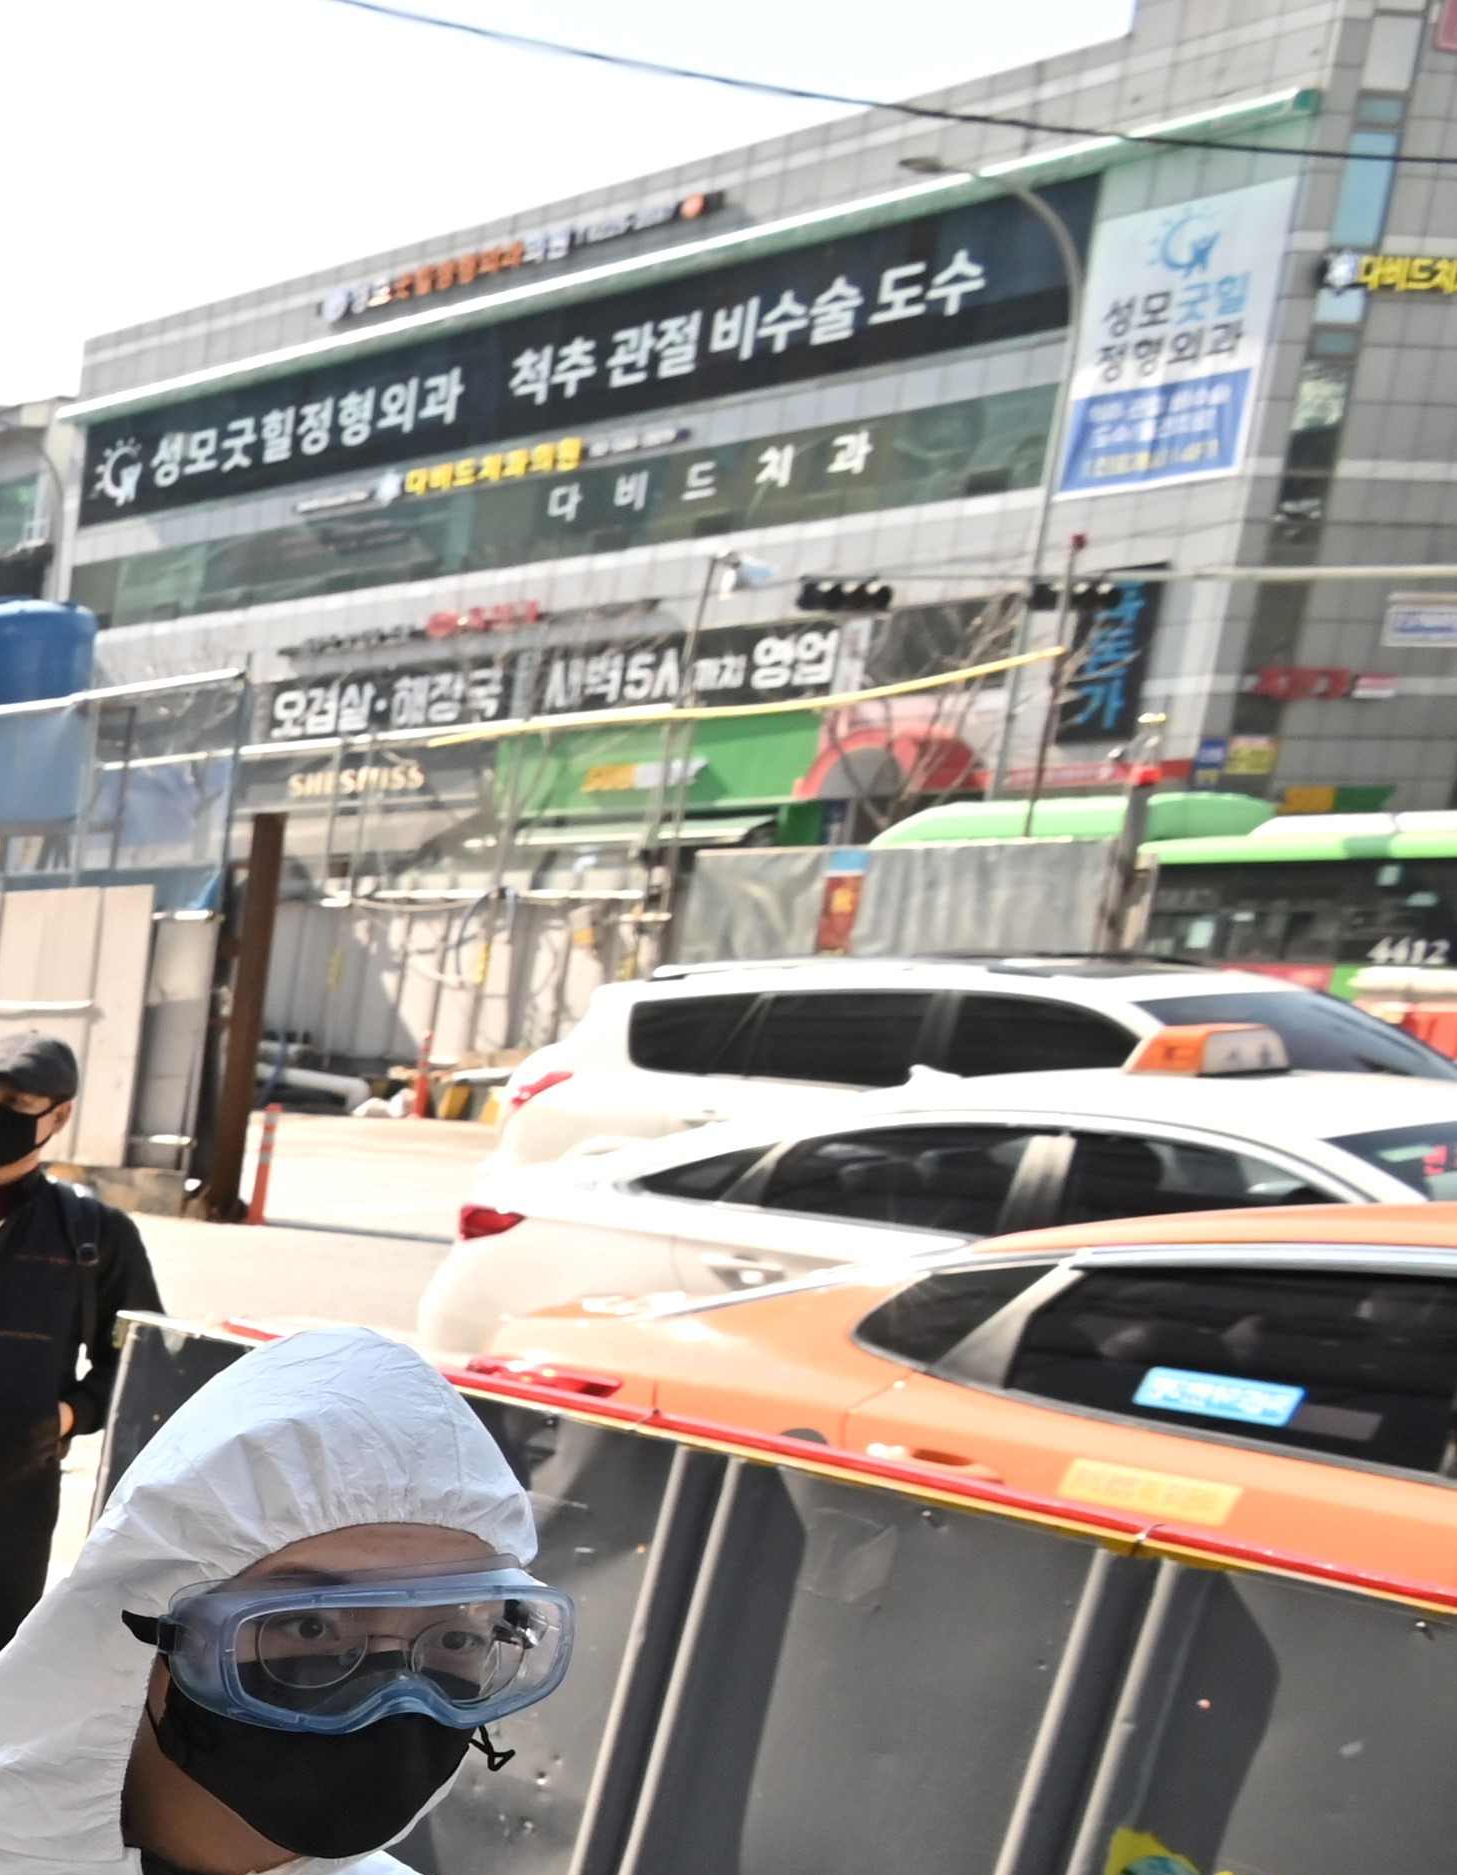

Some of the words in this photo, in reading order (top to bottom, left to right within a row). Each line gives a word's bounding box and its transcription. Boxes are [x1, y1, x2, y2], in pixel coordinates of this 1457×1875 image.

[149, 365, 464, 488] 성모굿힐정형외과
[508, 342, 598, 404] 척추
[606, 309, 703, 389] 관절
[710, 270, 865, 361] 비수술
[867, 249, 988, 328] 도수
[1366, 935, 1451, 965] 4412
